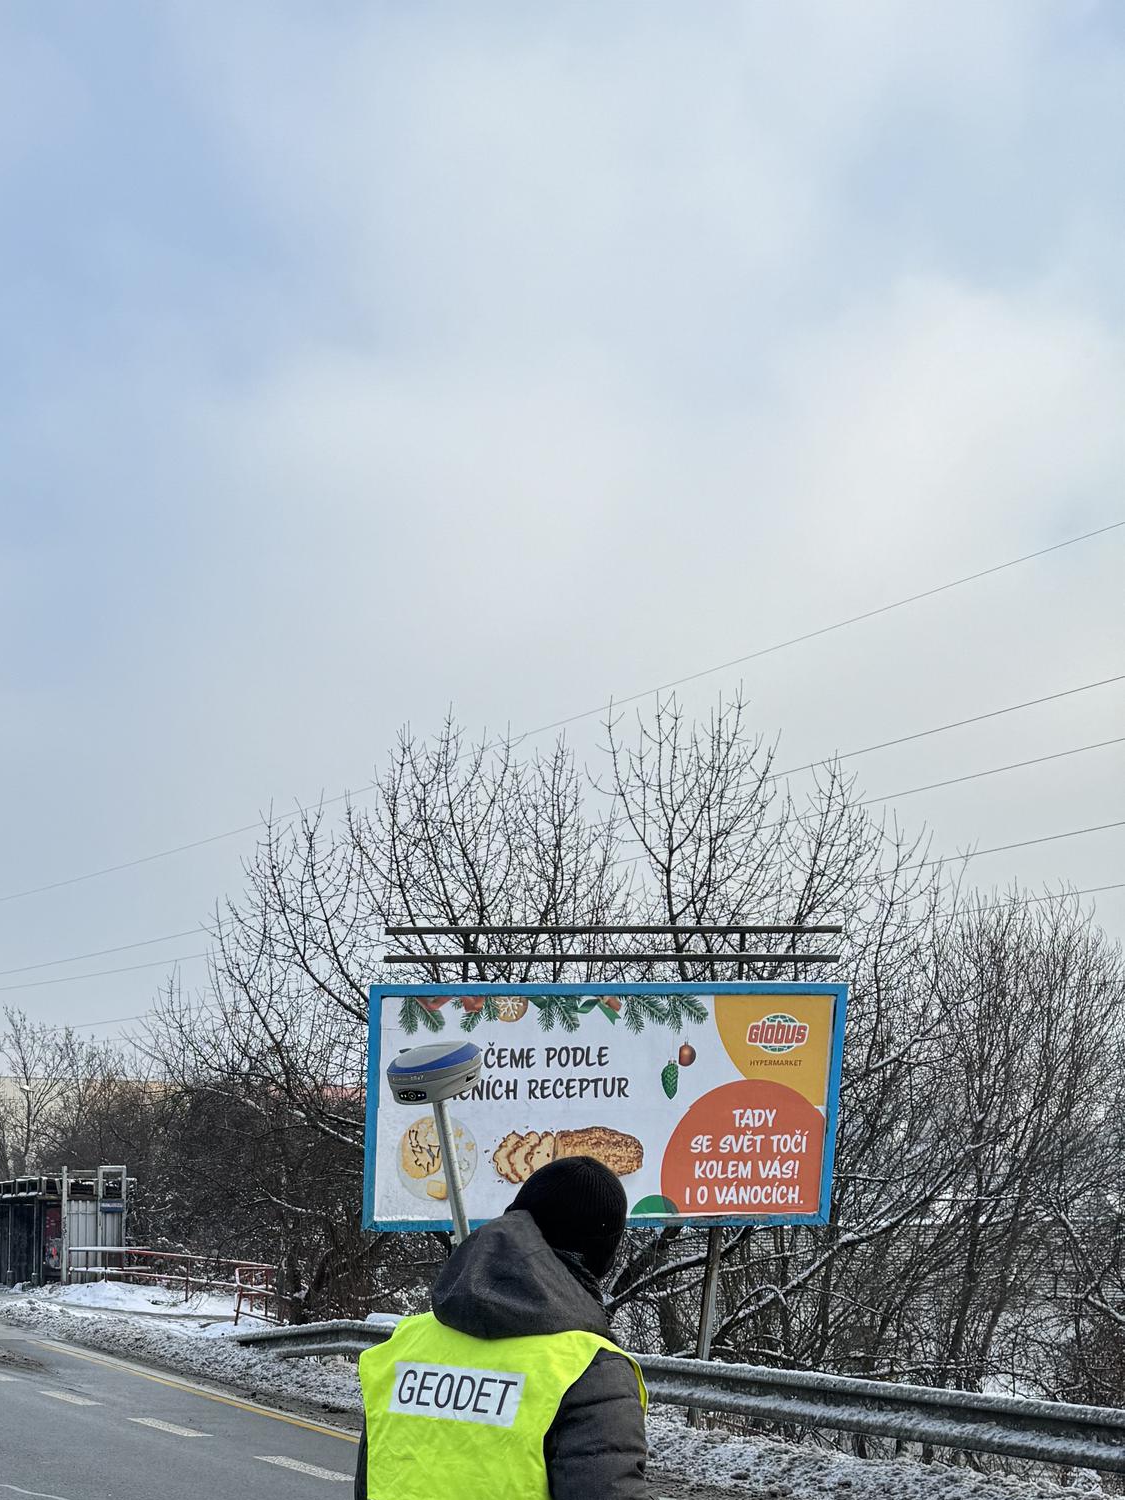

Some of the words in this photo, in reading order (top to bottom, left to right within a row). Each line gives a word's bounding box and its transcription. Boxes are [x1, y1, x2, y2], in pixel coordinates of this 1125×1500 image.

[747, 1020, 809, 1045] Globus
[480, 1042, 536, 1069] ČEME
[546, 1046, 610, 1069] PODLE
[749, 1059, 803, 1067] HYPERMARKET
[453, 1075, 518, 1101] NÍCH
[528, 1077, 630, 1100] RECEPTUR
[732, 1108, 777, 1128] TADY
[690, 1135, 713, 1154] SE
[719, 1130, 765, 1154] SVĚT
[770, 1129, 809, 1154] TOČÍ
[694, 1160, 752, 1179] KOLEM
[758, 1156, 799, 1179] VÁS!
[685, 1186, 690, 1205] I
[697, 1185, 708, 1205] O
[714, 1181, 804, 1205] VÁNOCÍCH.
[397, 1369, 518, 1416] GEODET
